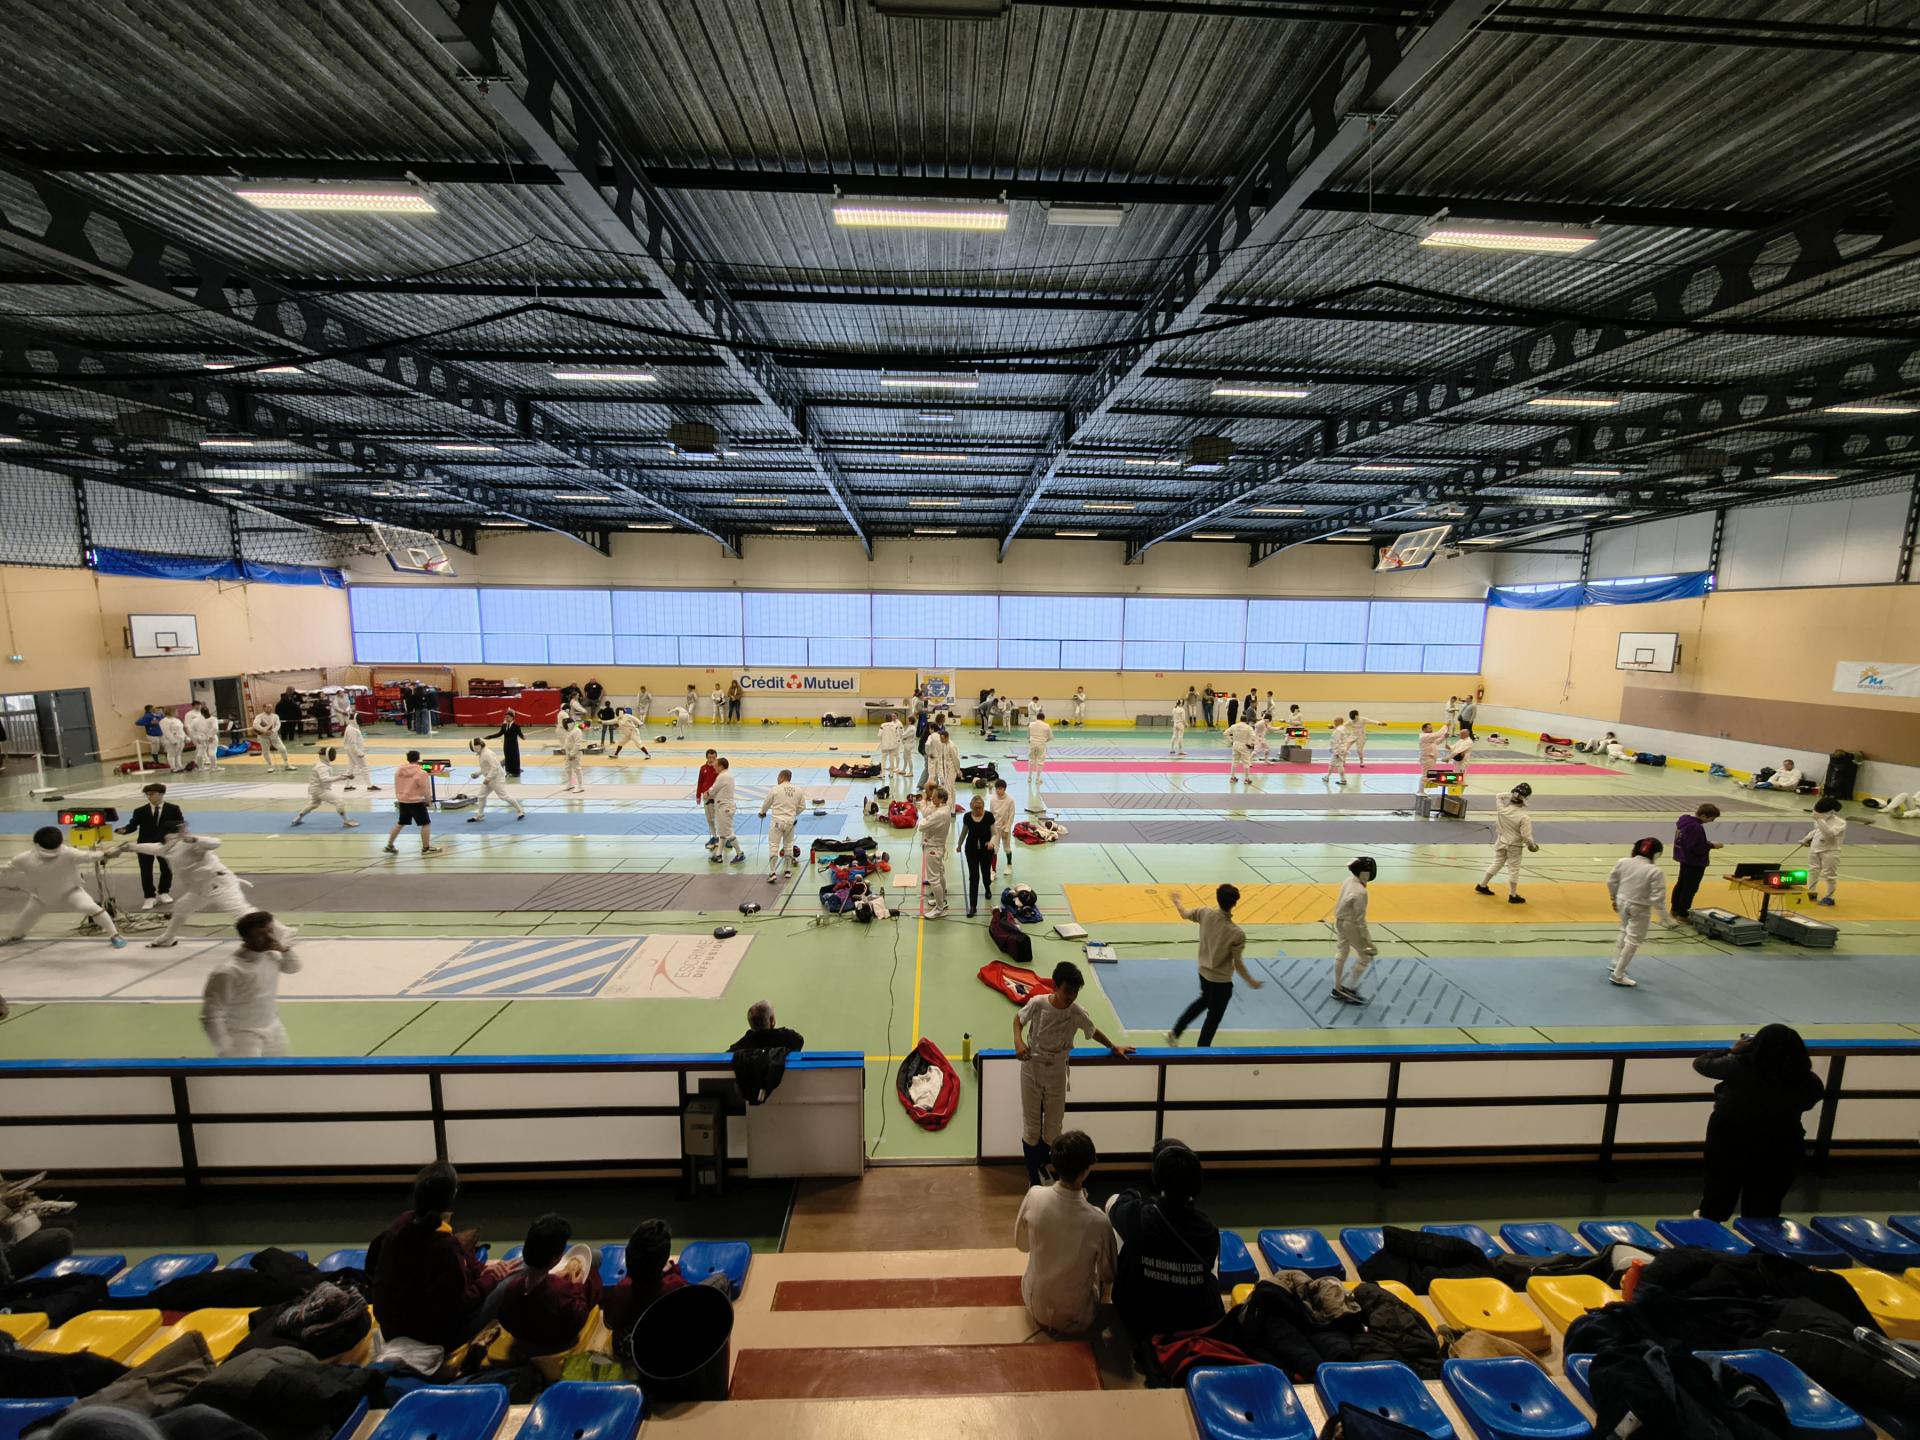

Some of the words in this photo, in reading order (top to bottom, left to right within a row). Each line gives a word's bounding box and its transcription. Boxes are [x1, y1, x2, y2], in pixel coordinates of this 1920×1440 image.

[740, 675, 785, 689] Crédit
[804, 676, 854, 690] Mutuel
[673, 939, 713, 978] ESCRIME
